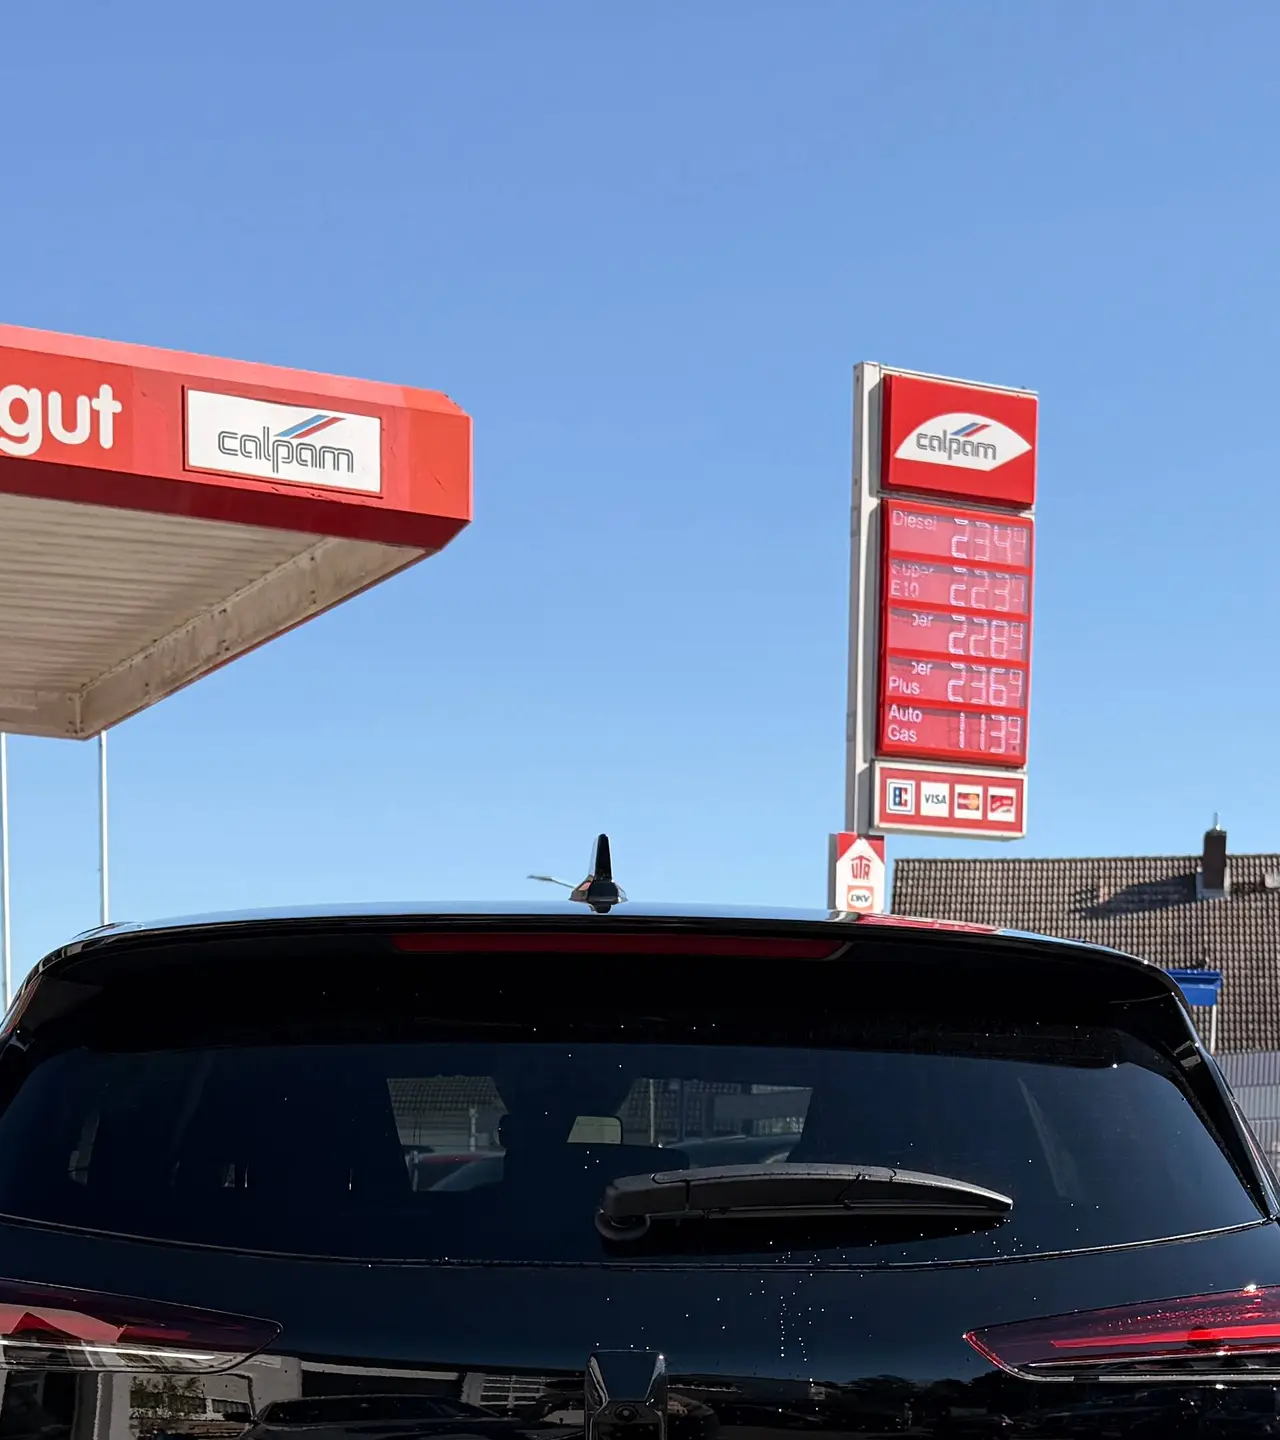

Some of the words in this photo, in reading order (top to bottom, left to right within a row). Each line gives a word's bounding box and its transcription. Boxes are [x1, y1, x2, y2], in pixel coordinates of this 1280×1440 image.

[218, 426, 354, 473] calpam
[916, 429, 997, 461] calpam
[892, 510, 937, 531] Diesel
[889, 677, 920, 695] Plus
[888, 704, 922, 723] Auto
[888, 725, 918, 743] Gas
[924, 794, 947, 805] VISA
